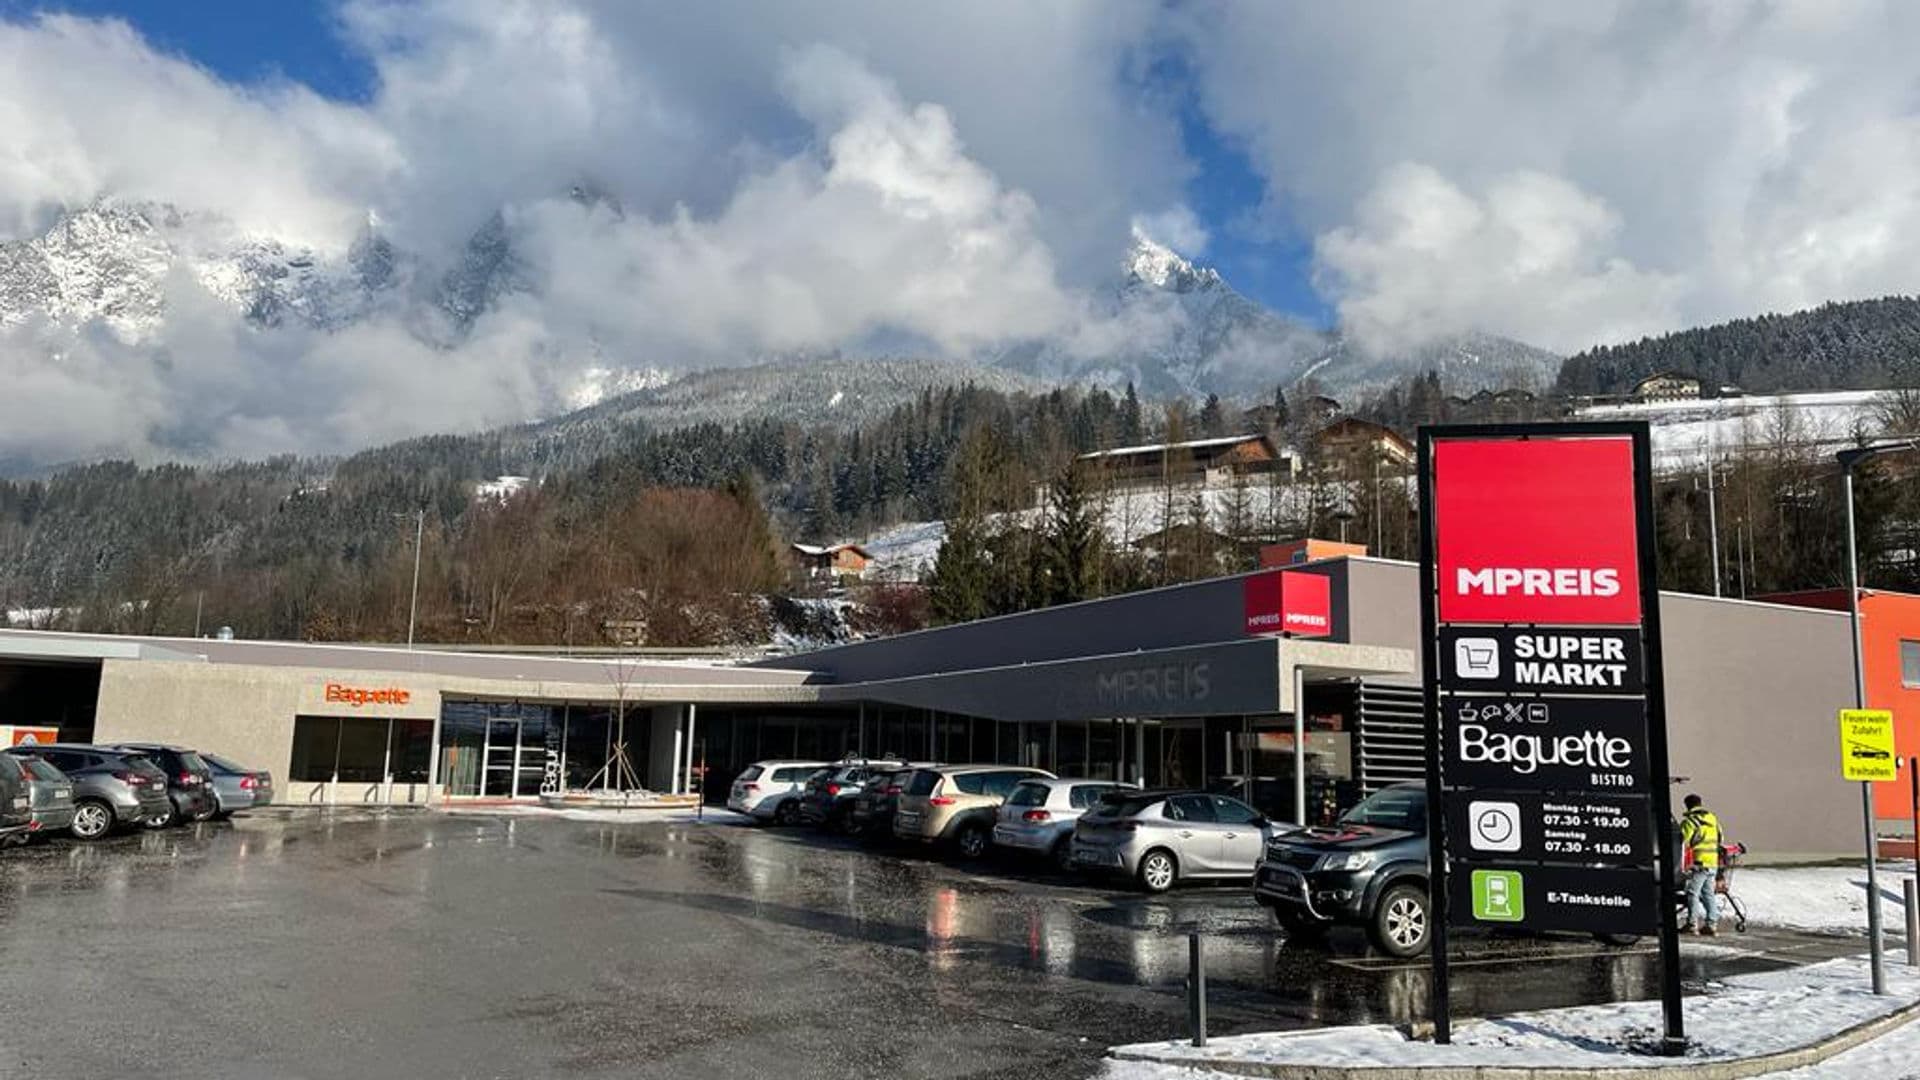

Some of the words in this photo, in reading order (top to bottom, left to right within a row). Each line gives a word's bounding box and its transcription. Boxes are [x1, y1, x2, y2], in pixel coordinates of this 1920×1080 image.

[1457, 568, 1620, 596] MPREIS
[1248, 613, 1279, 626] MPREIS
[1286, 613, 1326, 626] MPREIS
[1515, 635, 1626, 660] SUPER
[1515, 662, 1627, 686] MARKT
[1098, 664, 1210, 703] MPREIS
[326, 684, 410, 707] Baguette
[1459, 724, 1632, 774] Baguette
[1591, 773, 1634, 786] BISTRO
[1543, 803, 1579, 813] Montag
[1586, 804, 1621, 815] Freitag
[1543, 814, 1580, 826] 07.30
[1593, 816, 1629, 828] 19.00
[1545, 829, 1586, 840] Samstag
[1545, 841, 1582, 853] 07.30
[1594, 843, 1631, 854] 18.00
[1547, 892, 1631, 907] E-Tankstelle
